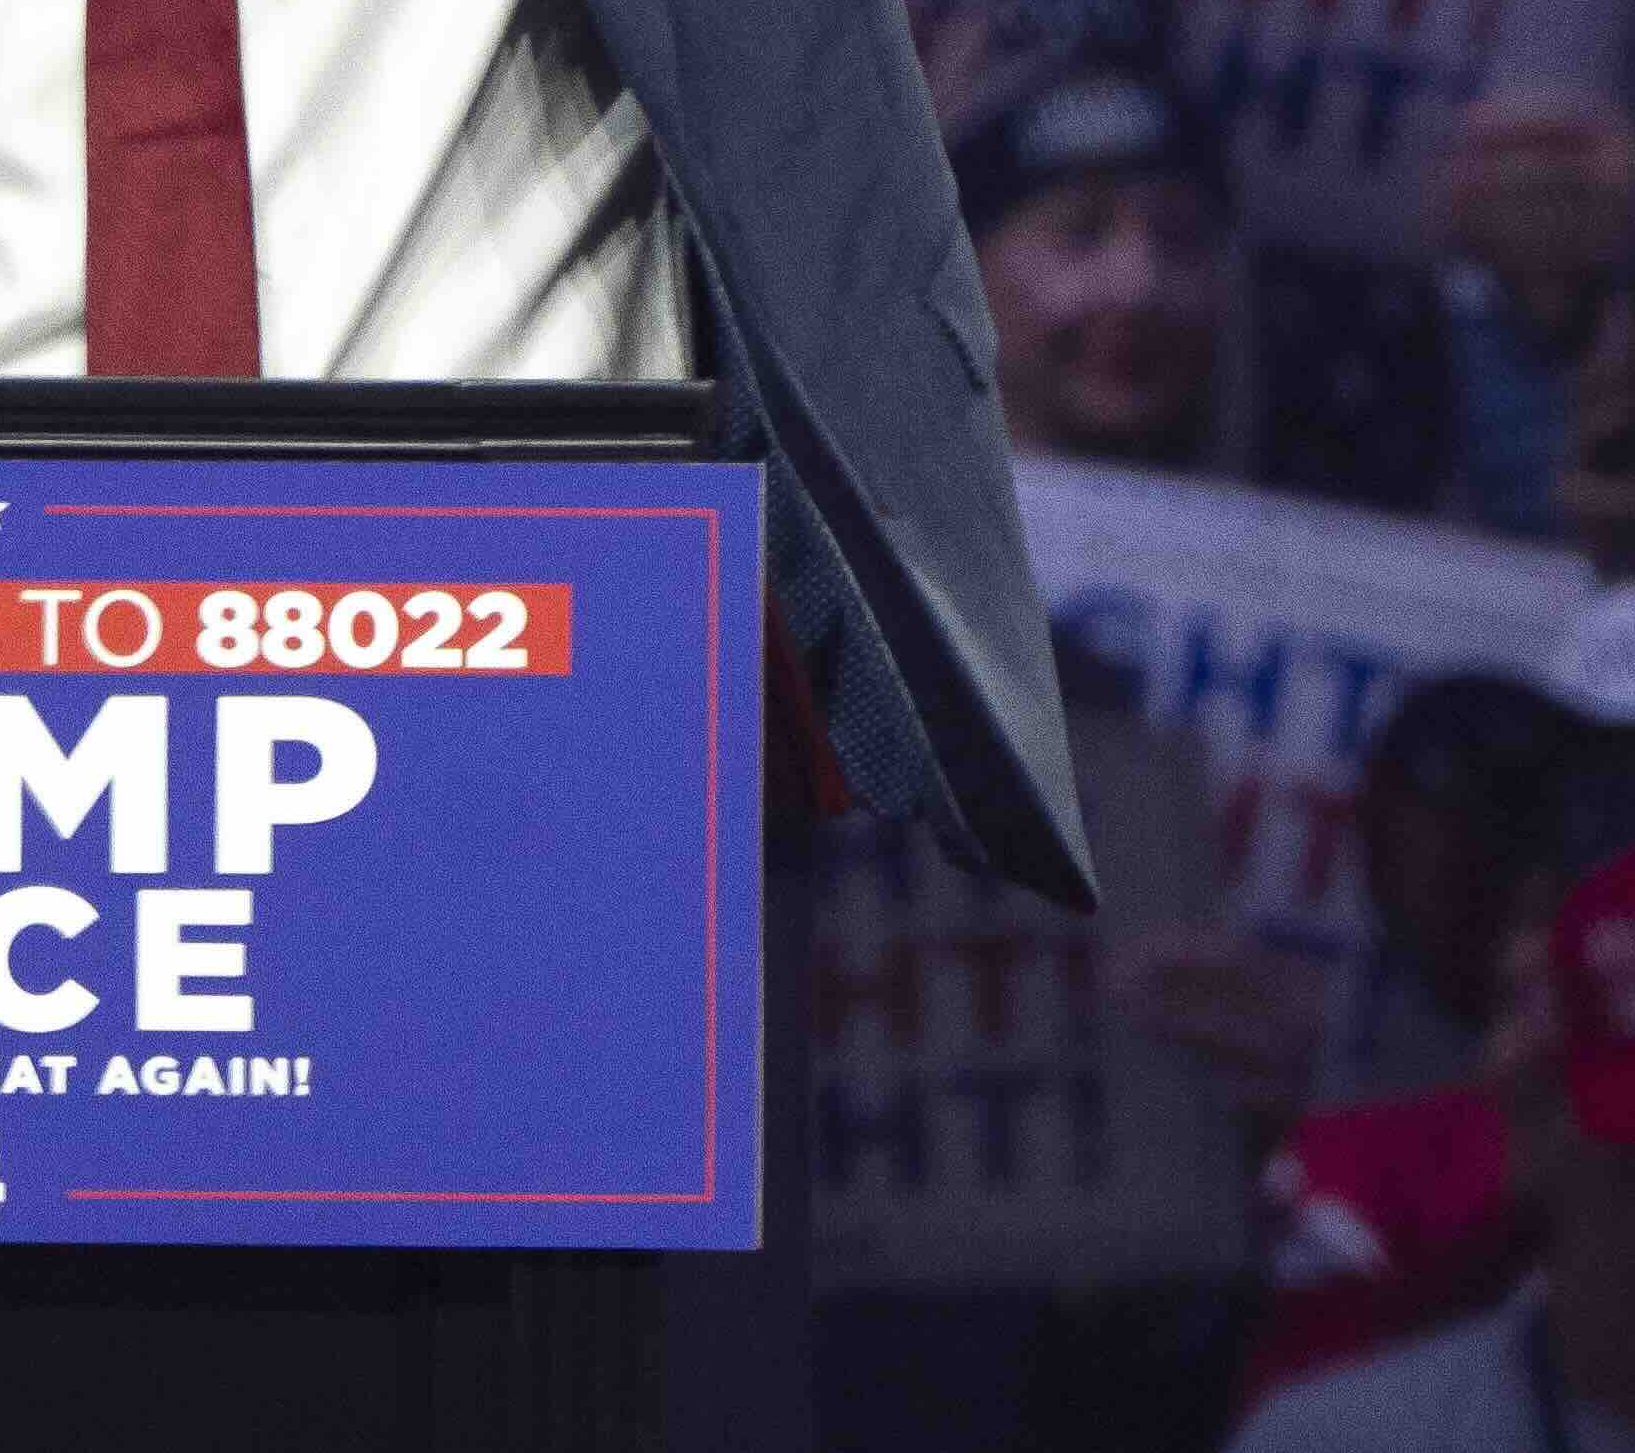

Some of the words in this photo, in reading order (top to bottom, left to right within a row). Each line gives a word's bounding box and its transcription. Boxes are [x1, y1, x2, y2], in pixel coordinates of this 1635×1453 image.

[20, 589, 163, 668] TO
[195, 589, 528, 670] 88022
[97, 1055, 312, 1096] AGAIN!
